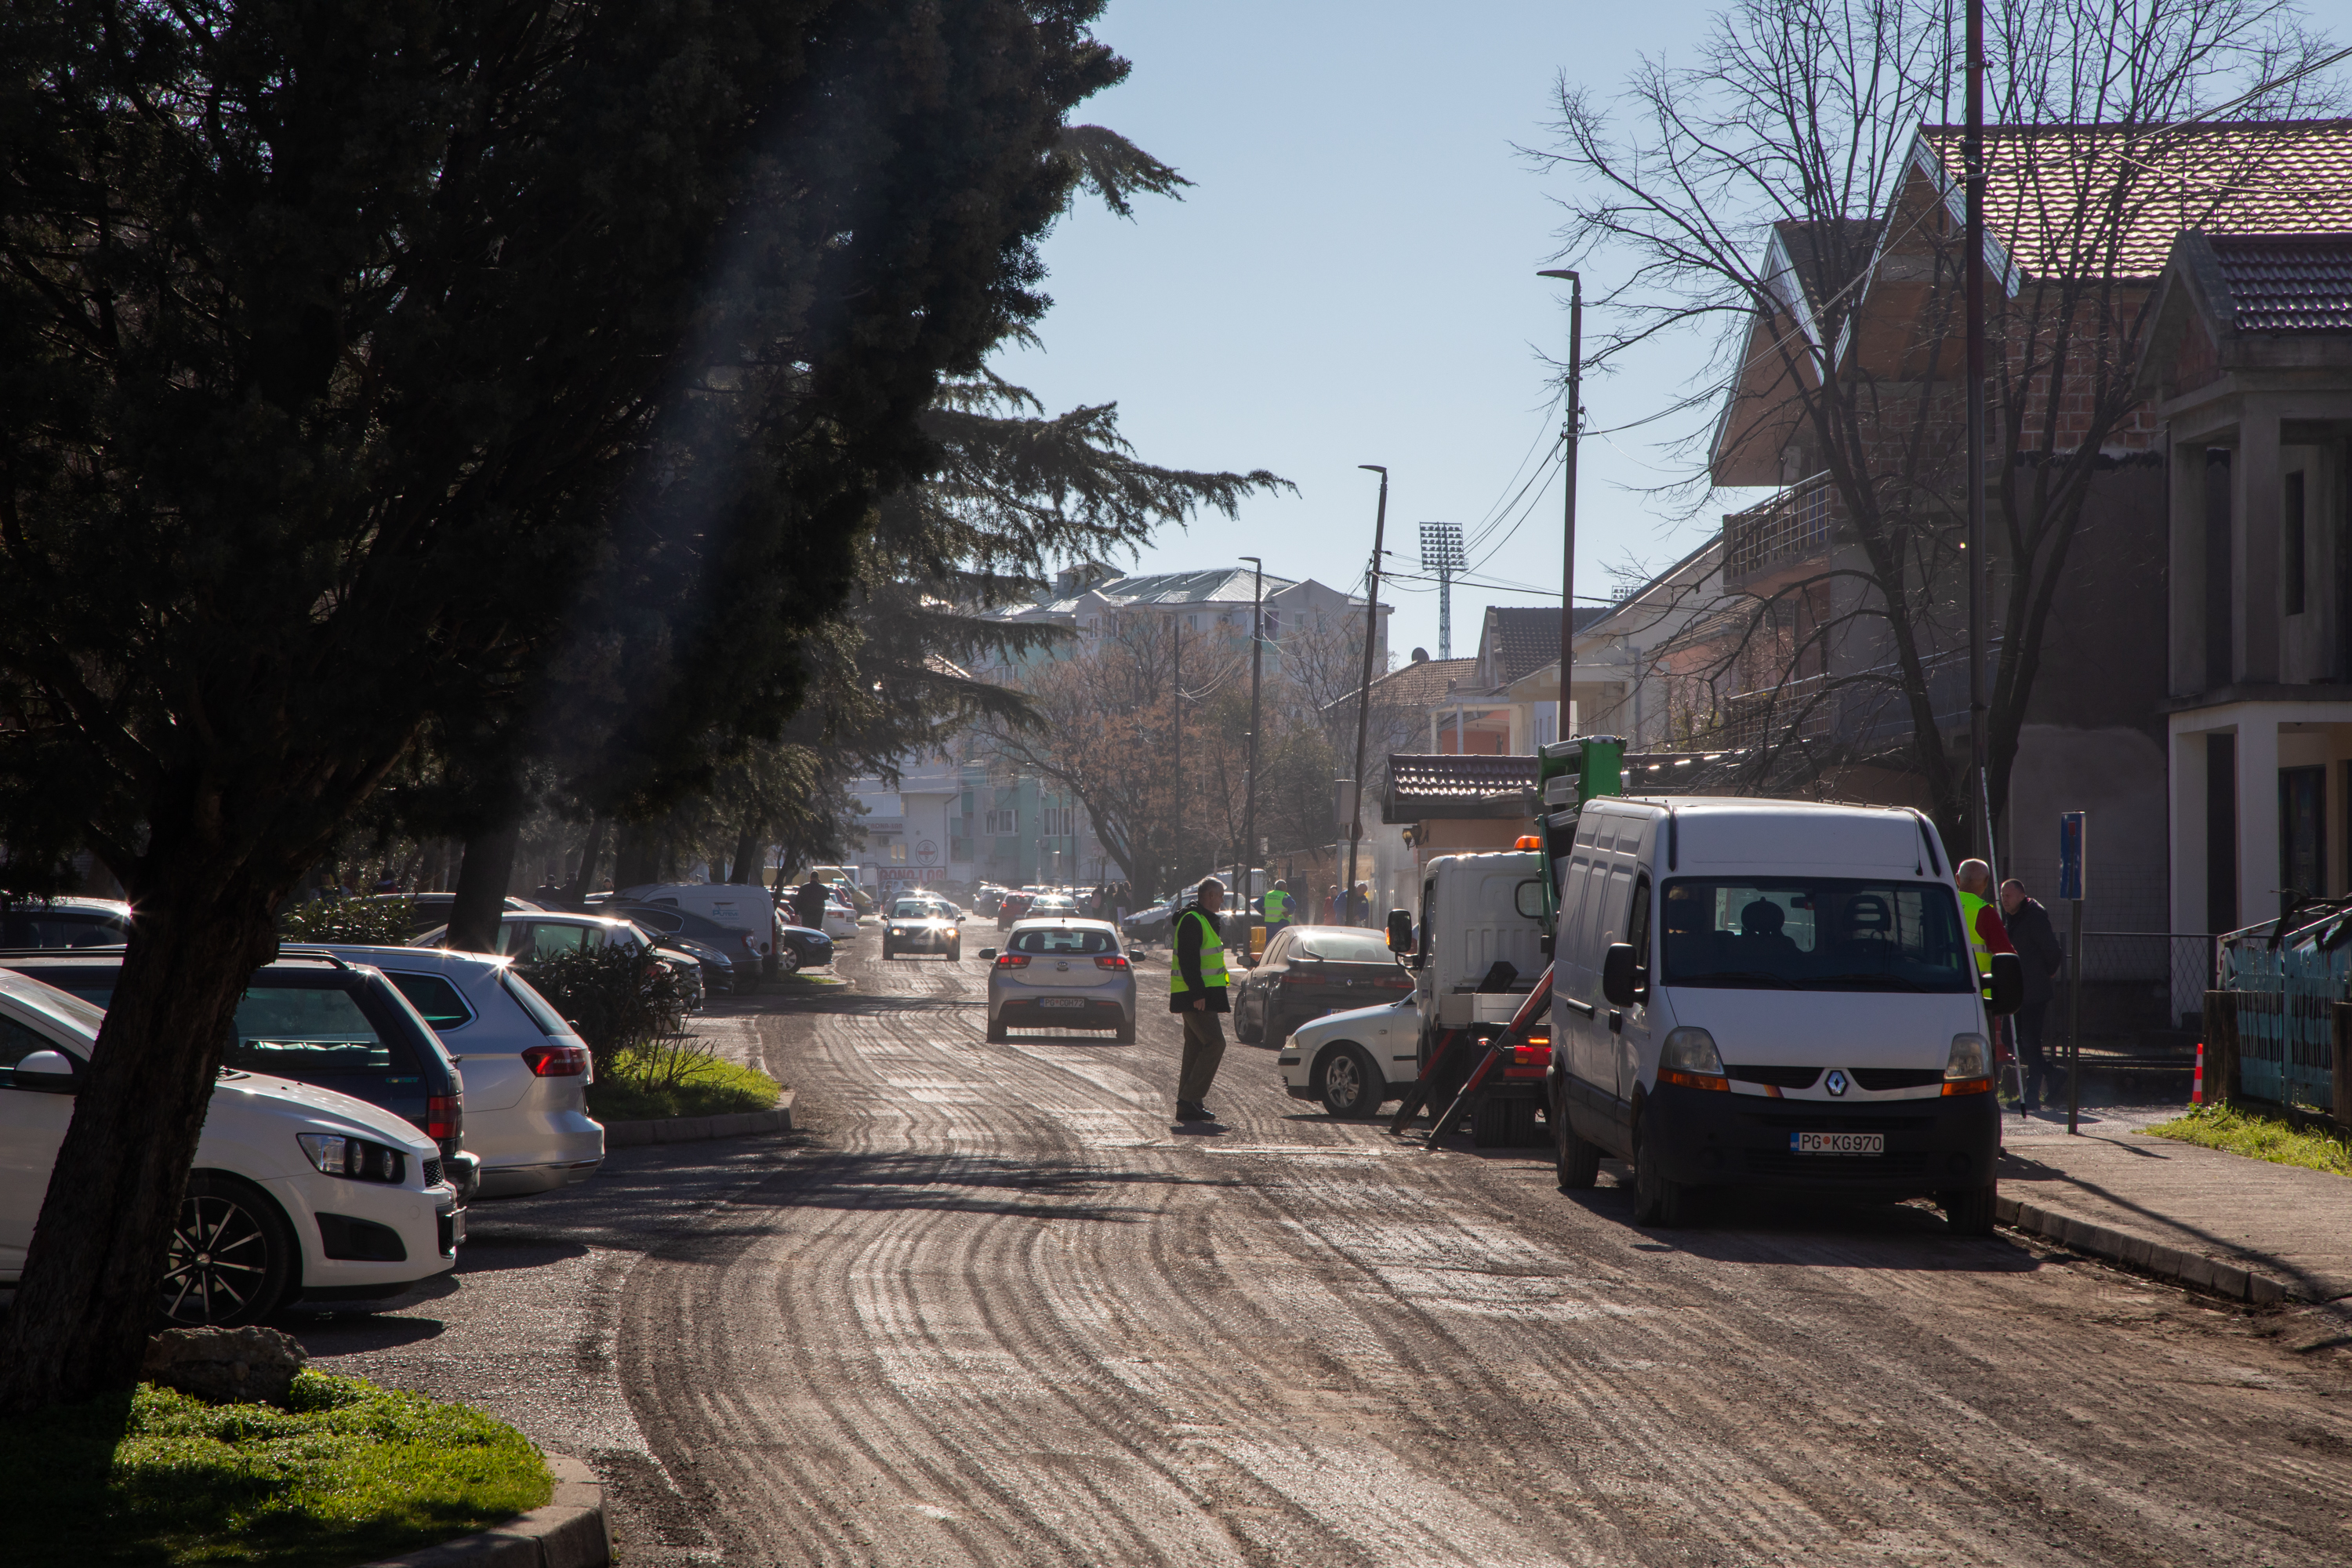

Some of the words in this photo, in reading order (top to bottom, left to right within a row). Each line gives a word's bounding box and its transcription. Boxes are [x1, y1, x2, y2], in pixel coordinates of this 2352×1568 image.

[1059, 999, 1083, 1007] CGH72
[1802, 1134, 1821, 1149] PG
[1832, 1135, 1882, 1151] KG970
